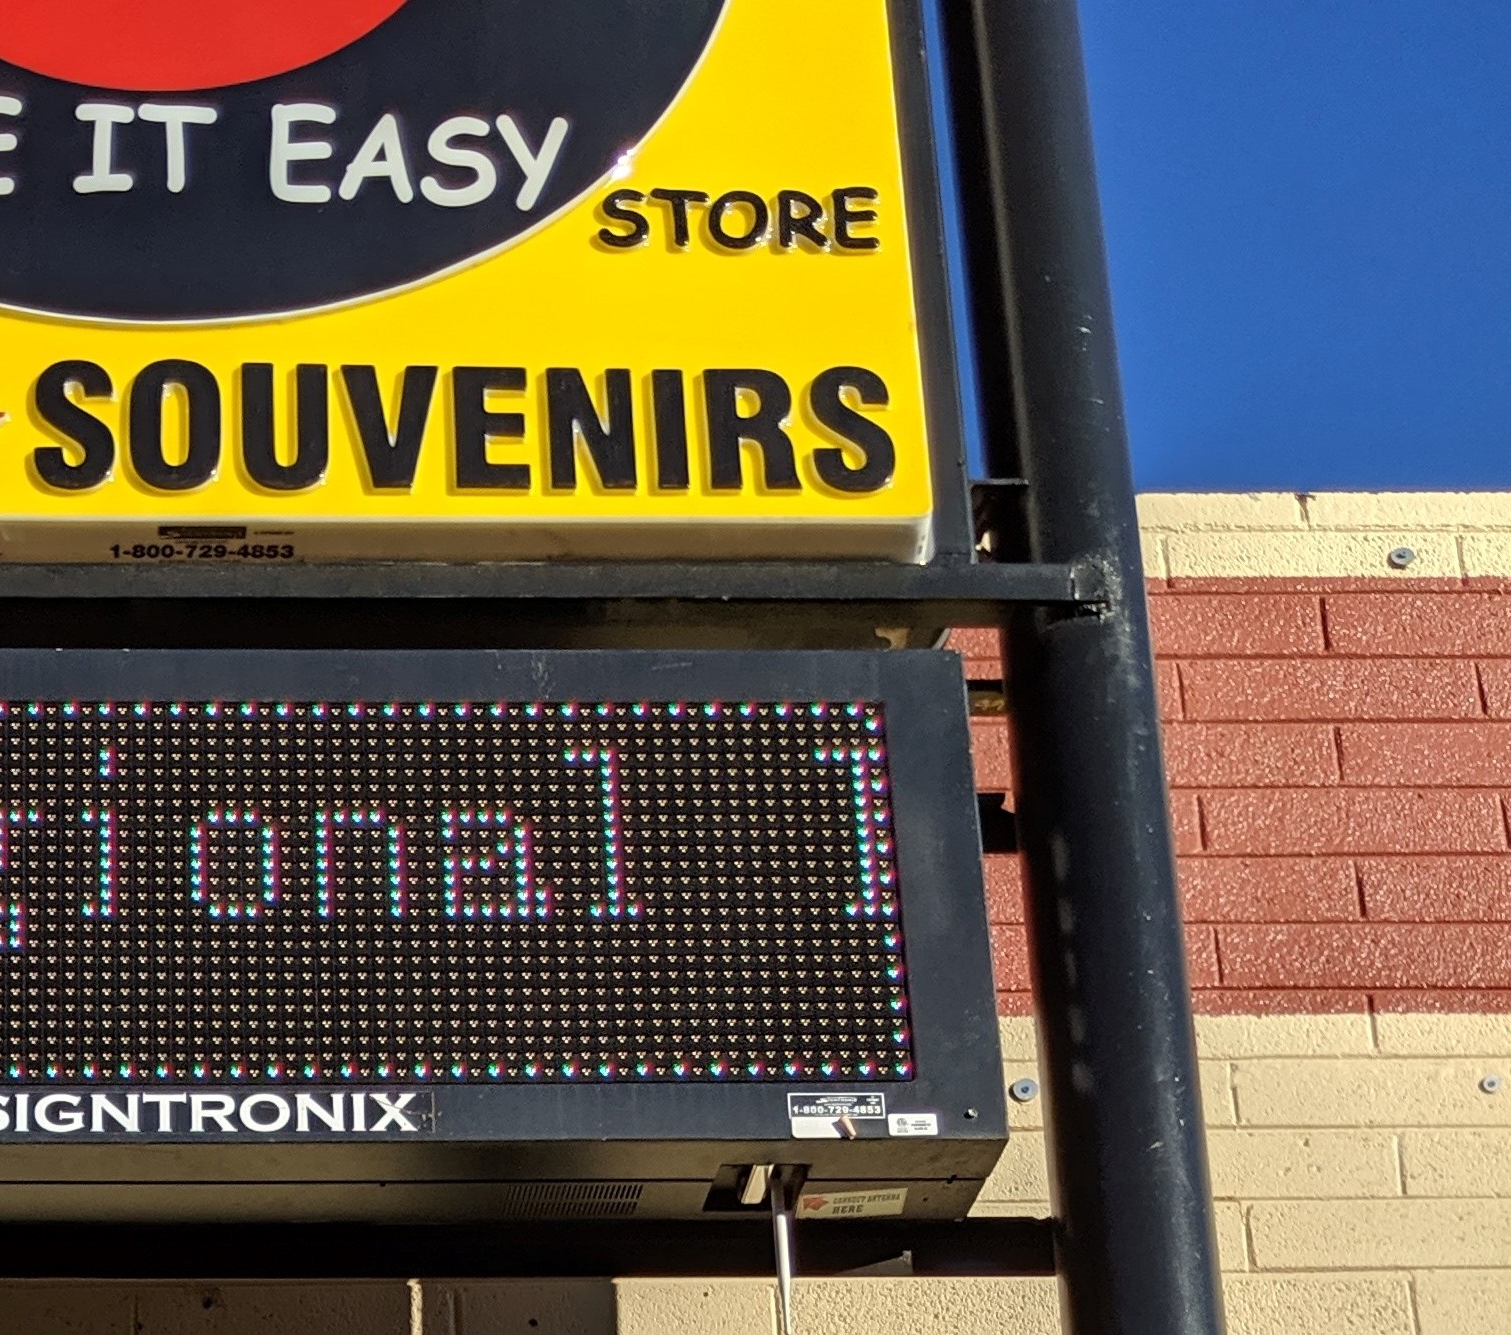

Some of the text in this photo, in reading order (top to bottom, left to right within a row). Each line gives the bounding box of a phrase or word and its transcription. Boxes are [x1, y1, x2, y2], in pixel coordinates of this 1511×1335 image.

[72, 102, 218, 194] IT
[269, 103, 569, 212] EASY
[597, 186, 881, 251] STORE
[31, 358, 897, 494] SOUVENIRS
[110, 544, 295, 558] 1-800-729-4853
[792, 1105, 881, 1114] 1-800-729-4853
[832, 1204, 864, 1215] HERE
